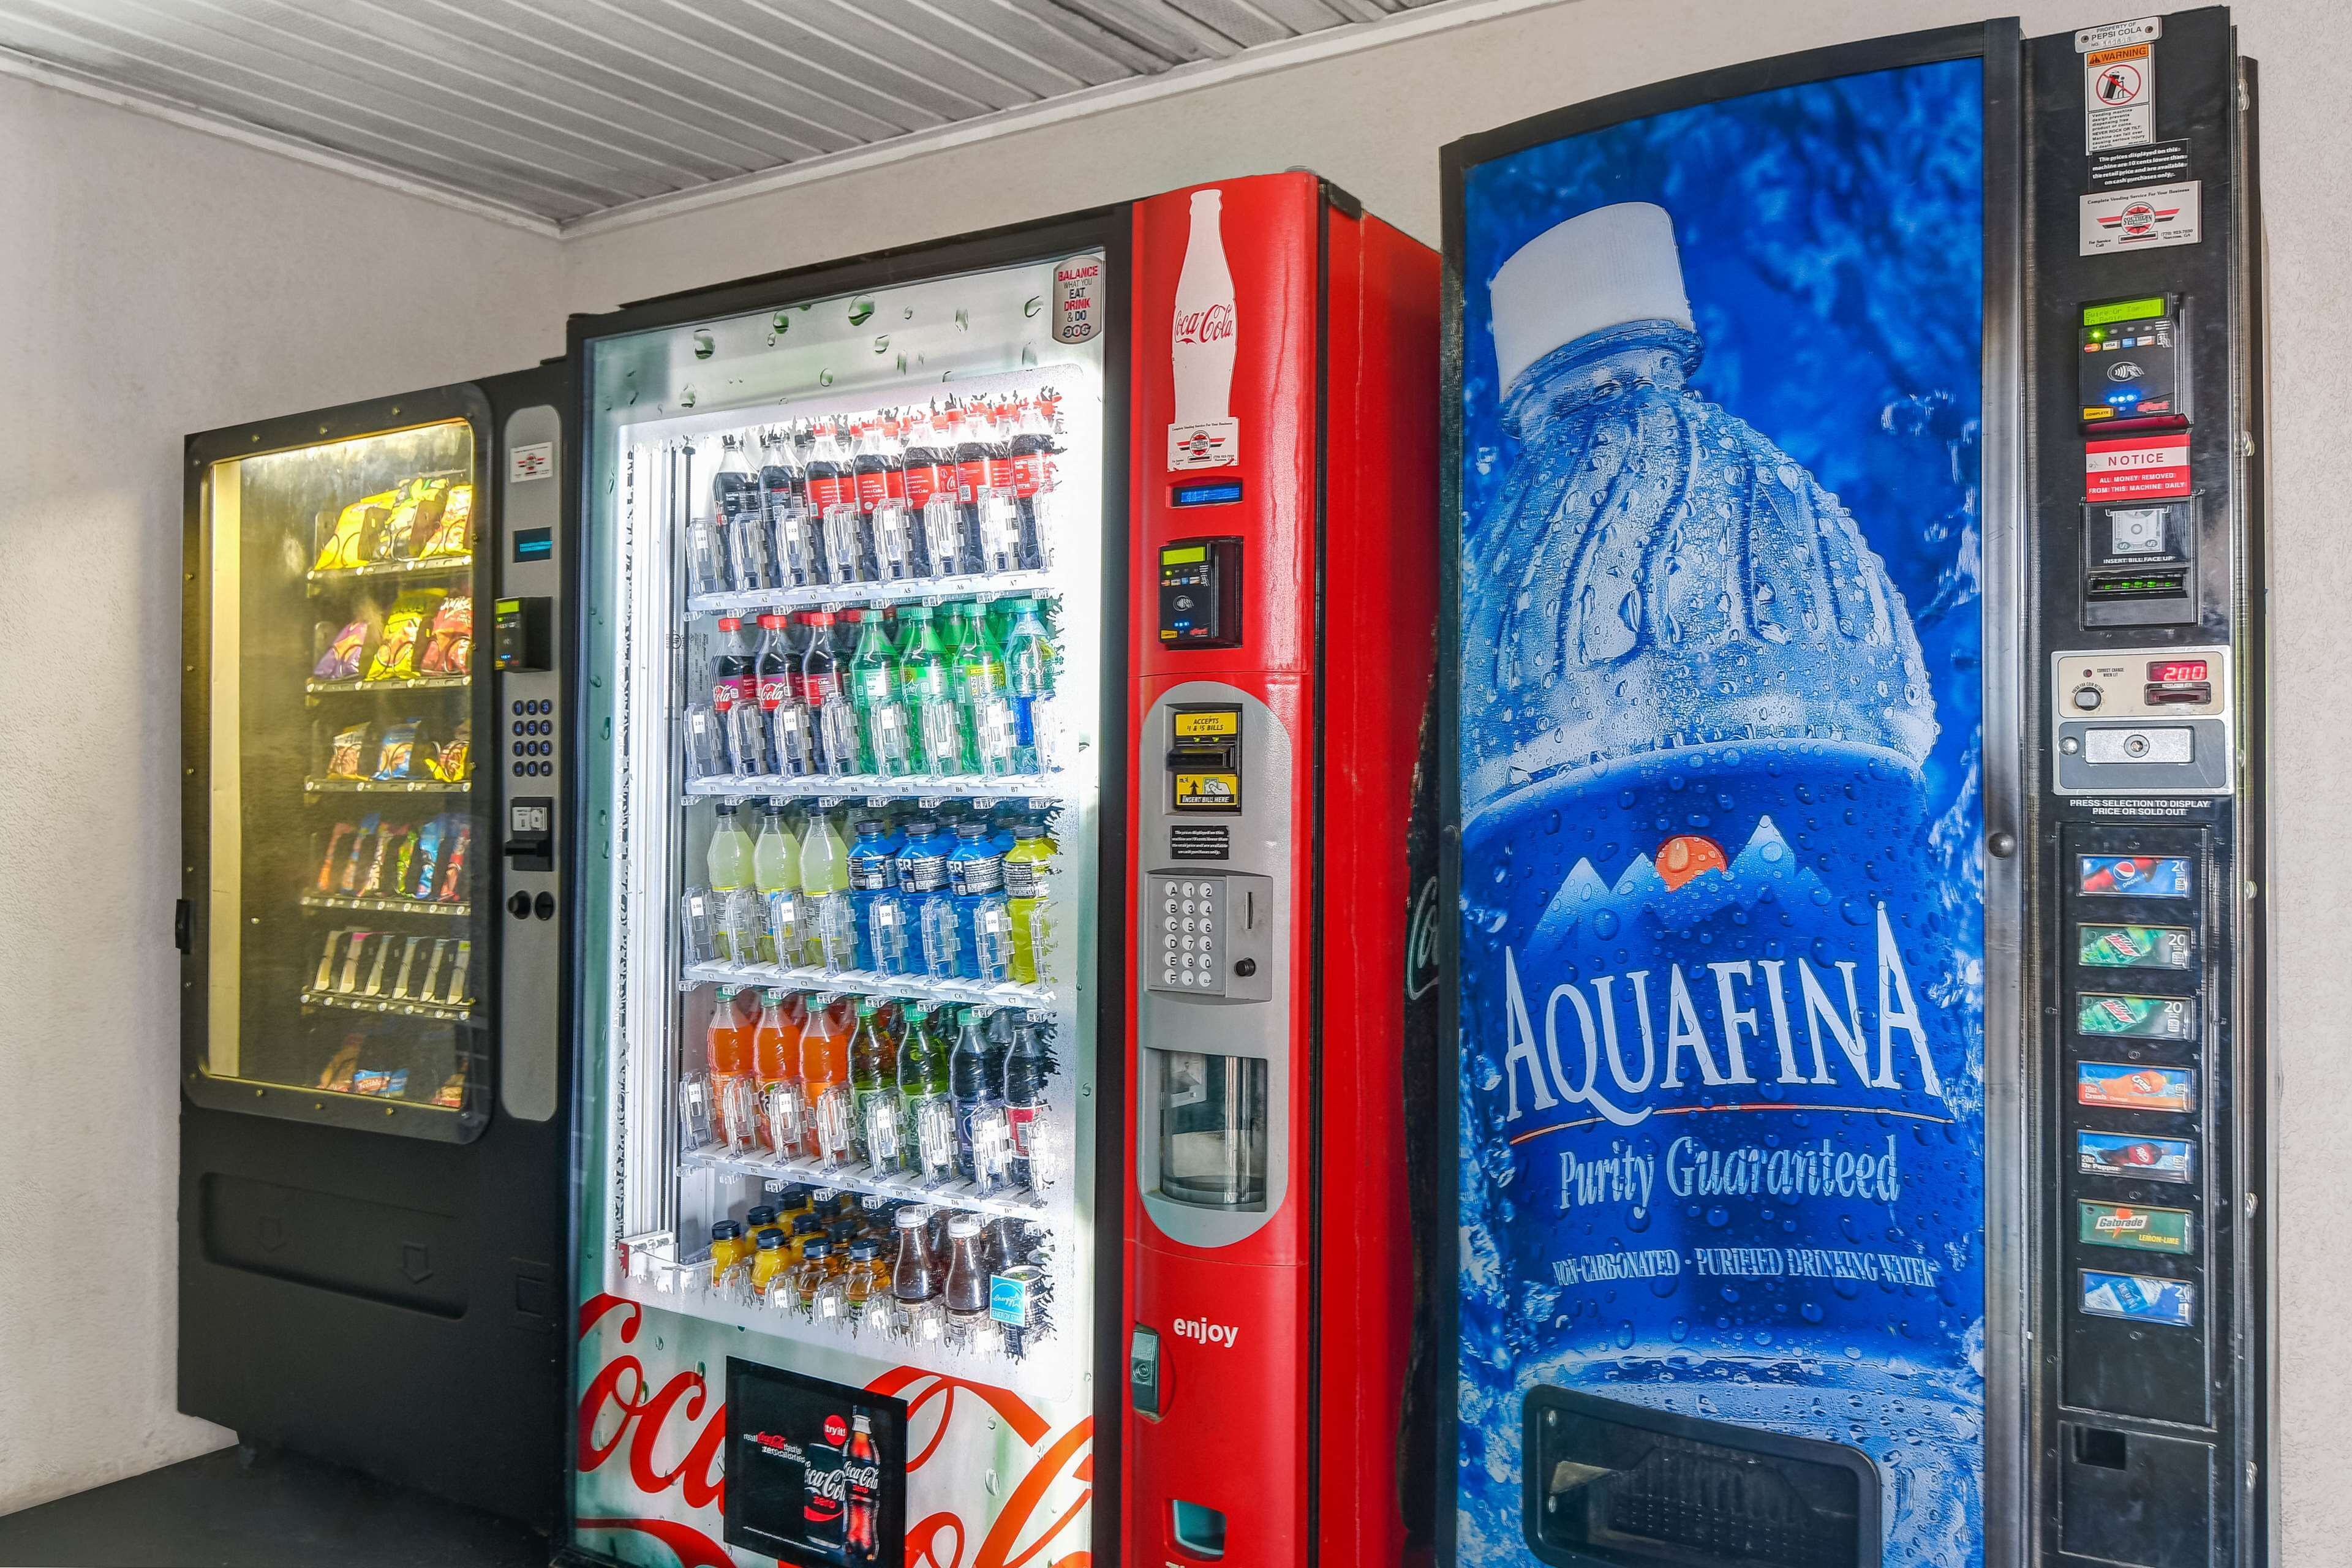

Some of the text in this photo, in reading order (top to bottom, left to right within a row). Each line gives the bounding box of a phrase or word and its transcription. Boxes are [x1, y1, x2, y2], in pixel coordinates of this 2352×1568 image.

[2097, 22, 2127, 32] PROPERTY
[2091, 26, 2141, 40] PEPSI COLA
[2101, 47, 2146, 61] WARNING
[2128, 149, 2157, 158] displayed
[2127, 175, 2157, 183] purchases
[1058, 265, 1098, 282] BALANCE
[1063, 280, 1080, 289] WHAT
[1064, 298, 1090, 312] DRINK
[1067, 310, 1087, 322] & DO
[1174, 304, 1234, 344] Coca-Cola
[2108, 453, 2163, 466] NOTICE
[2163, 666, 2204, 680] 2.00
[761, 683, 784, 701] Cola
[2122, 877, 2140, 888] pepsi
[1170, 887, 1177, 895] A
[1205, 888, 1212, 897] 2
[1170, 904, 1177, 913] B
[1188, 905, 1194, 914] 3
[1205, 905, 1212, 914] 4
[1170, 922, 1177, 930] C
[1188, 922, 1194, 932] 5
[1205, 924, 1212, 932] 6
[1170, 939, 1177, 948] D
[1188, 940, 1194, 949] 7
[2168, 934, 2185, 946] 20
[1205, 941, 1212, 950] 8
[1170, 957, 1177, 966] E
[1188, 957, 1193, 967] 9
[1205, 959, 1211, 968] 0
[1170, 974, 1177, 983] F
[2164, 1001, 2182, 1013] 20
[1506, 901, 1942, 1126] AQUAFINA
[1560, 1134, 1900, 1219] Purity Guaranteed
[2100, 1218, 2143, 1227] Gatorade
[2139, 1234, 2179, 1245] LEMON-LIME
[1552, 1248, 1937, 1287] NON-CARBONATED PURIFIED DRINKING WATER
[1173, 1317, 1239, 1348] enjoy
[824, 1423, 838, 1434] try
[744, 1433, 758, 1442] real
[783, 1444, 802, 1454] taste
[761, 1446, 806, 1463] zero calories
[853, 1484, 869, 1494] zero
[813, 1496, 836, 1509] zero
